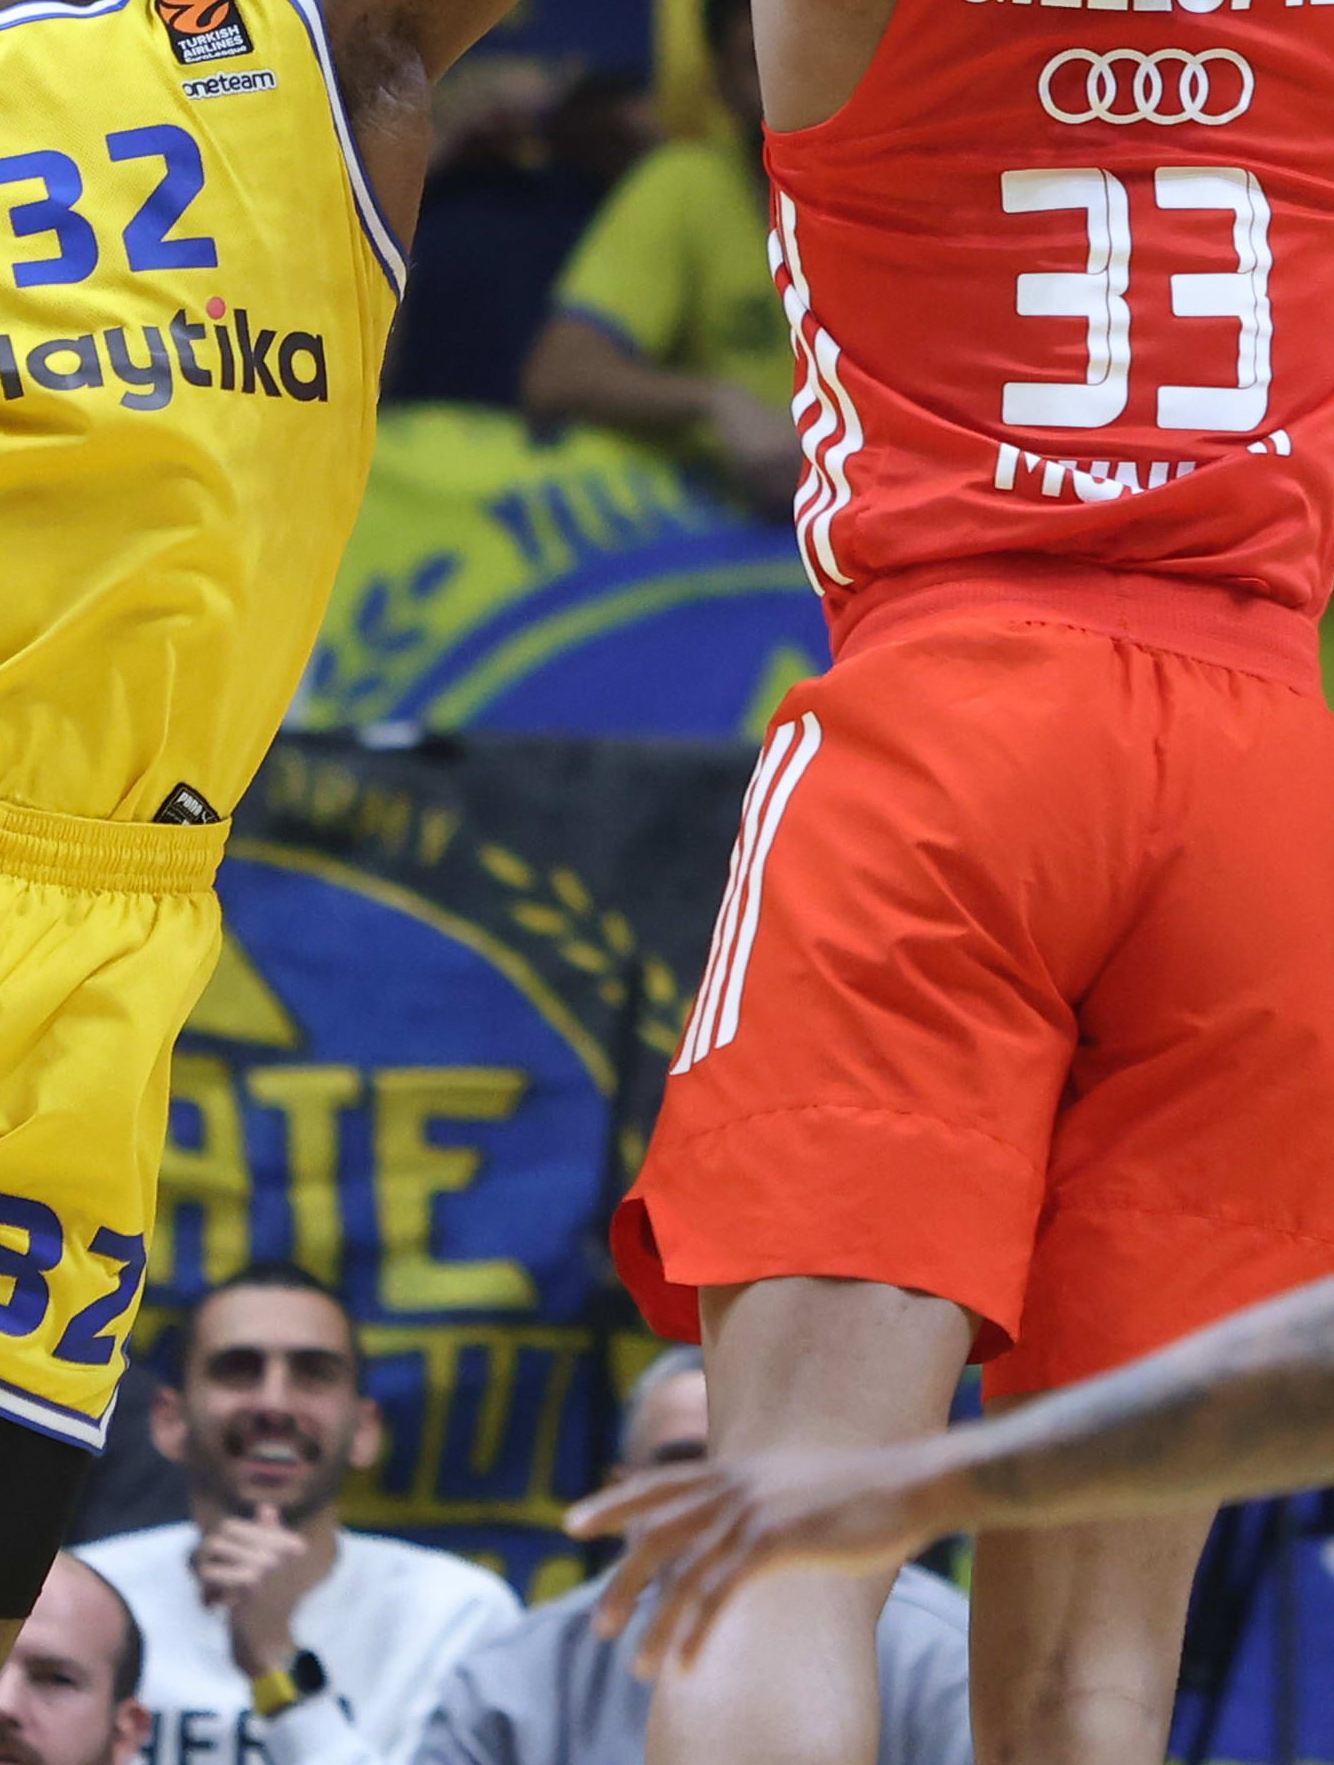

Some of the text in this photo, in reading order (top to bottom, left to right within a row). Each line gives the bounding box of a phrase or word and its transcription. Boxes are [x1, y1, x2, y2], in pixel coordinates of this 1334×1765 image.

[178, 24, 240, 51] TURKISH
[183, 35, 244, 58] AIRLINES
[182, 72, 275, 97] oneteam
[1000, 166, 1273, 433] 33
